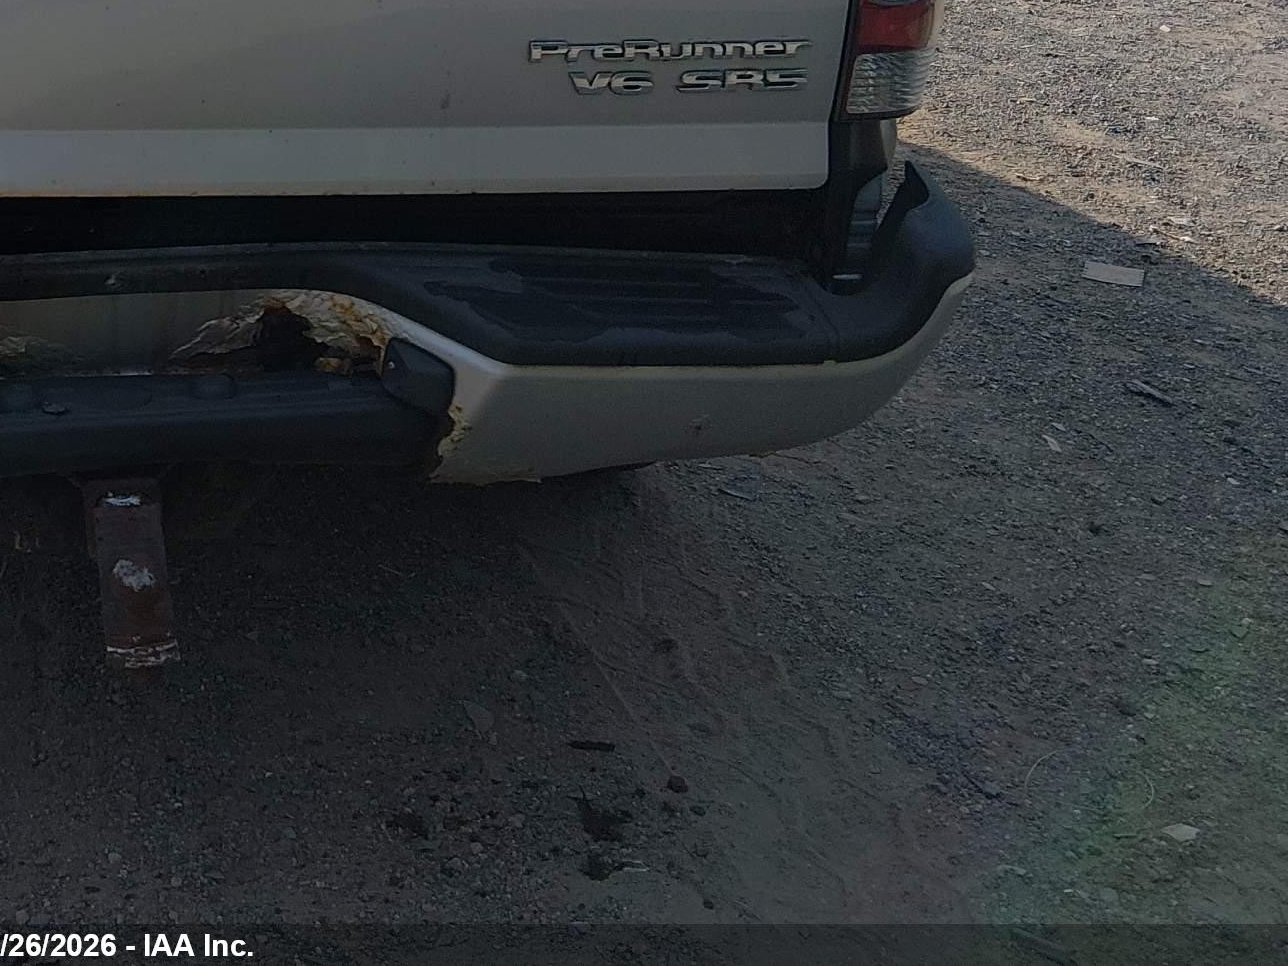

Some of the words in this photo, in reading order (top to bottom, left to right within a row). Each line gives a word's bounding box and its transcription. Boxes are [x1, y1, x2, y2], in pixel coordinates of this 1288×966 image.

[529, 40, 810, 62] PreRunner
[569, 71, 654, 95] V6
[676, 68, 809, 93] SR5
